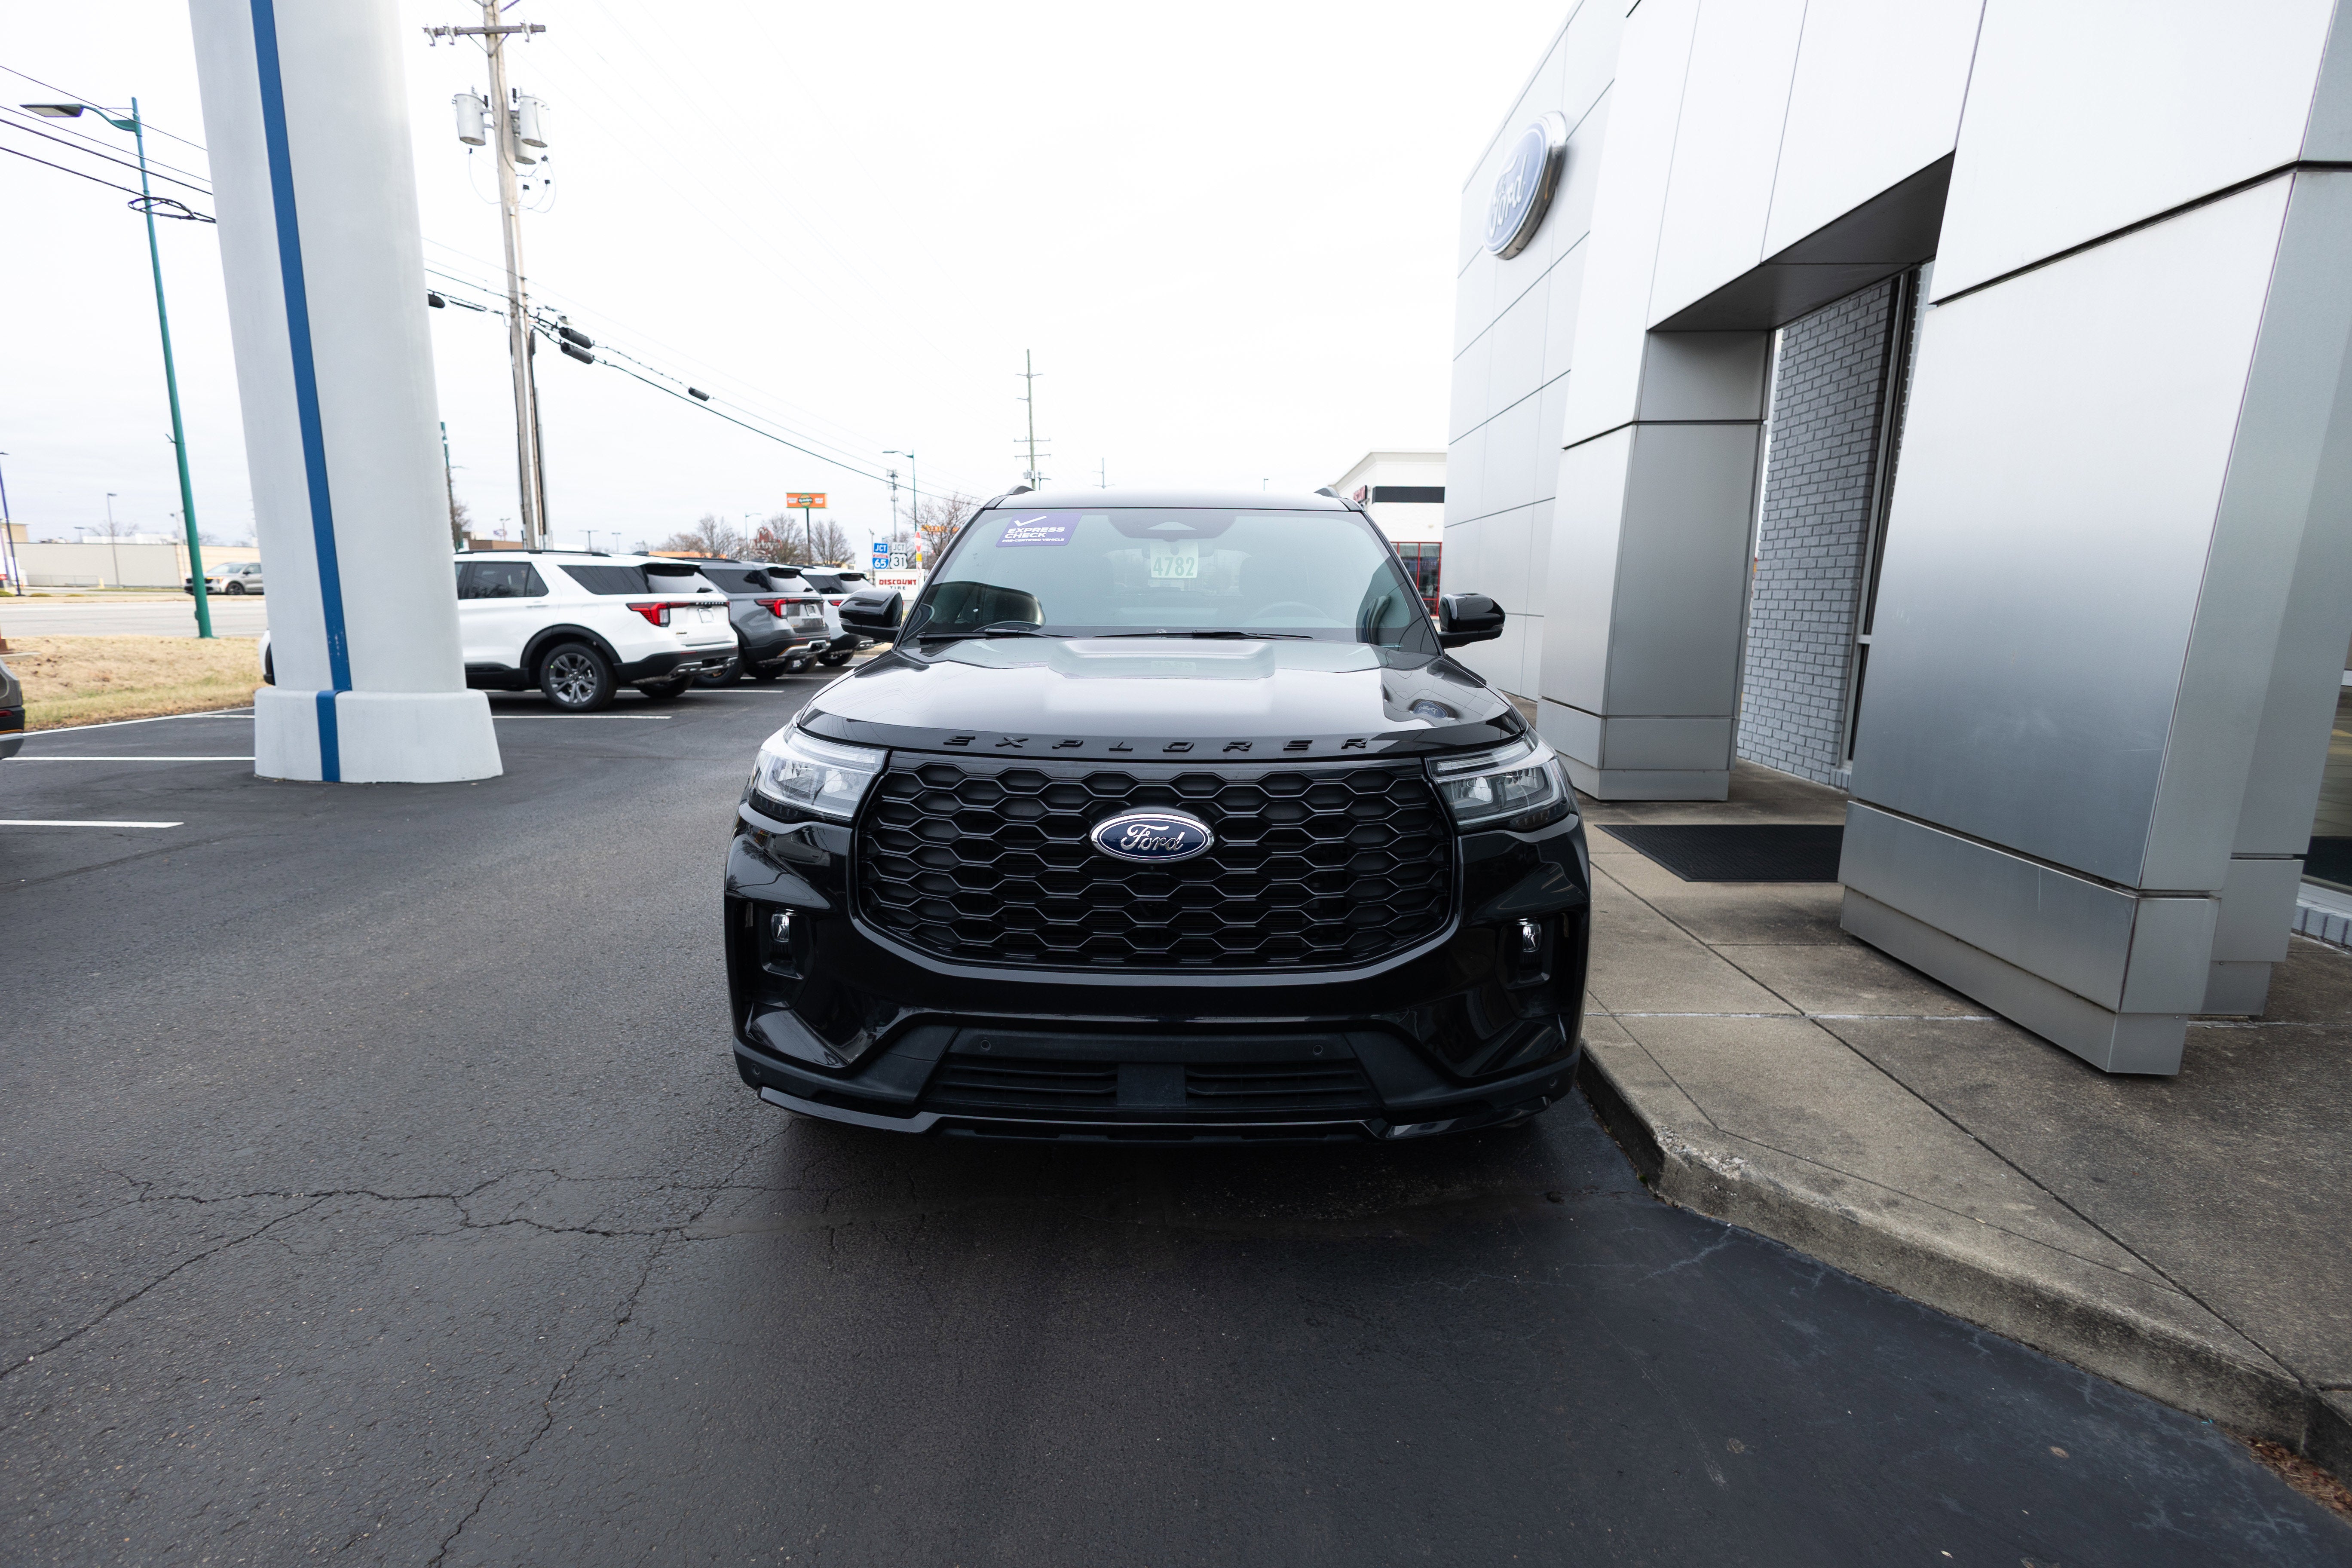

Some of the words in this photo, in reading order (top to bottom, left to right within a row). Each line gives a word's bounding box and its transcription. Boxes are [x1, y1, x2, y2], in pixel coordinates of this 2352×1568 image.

[1489, 154, 1528, 239] Ford
[874, 559, 887, 568] 65
[894, 557, 904, 567] 31
[1153, 557, 1194, 576] 4782
[943, 735, 1368, 753] EXPLORER
[1121, 824, 1185, 851] Ford
